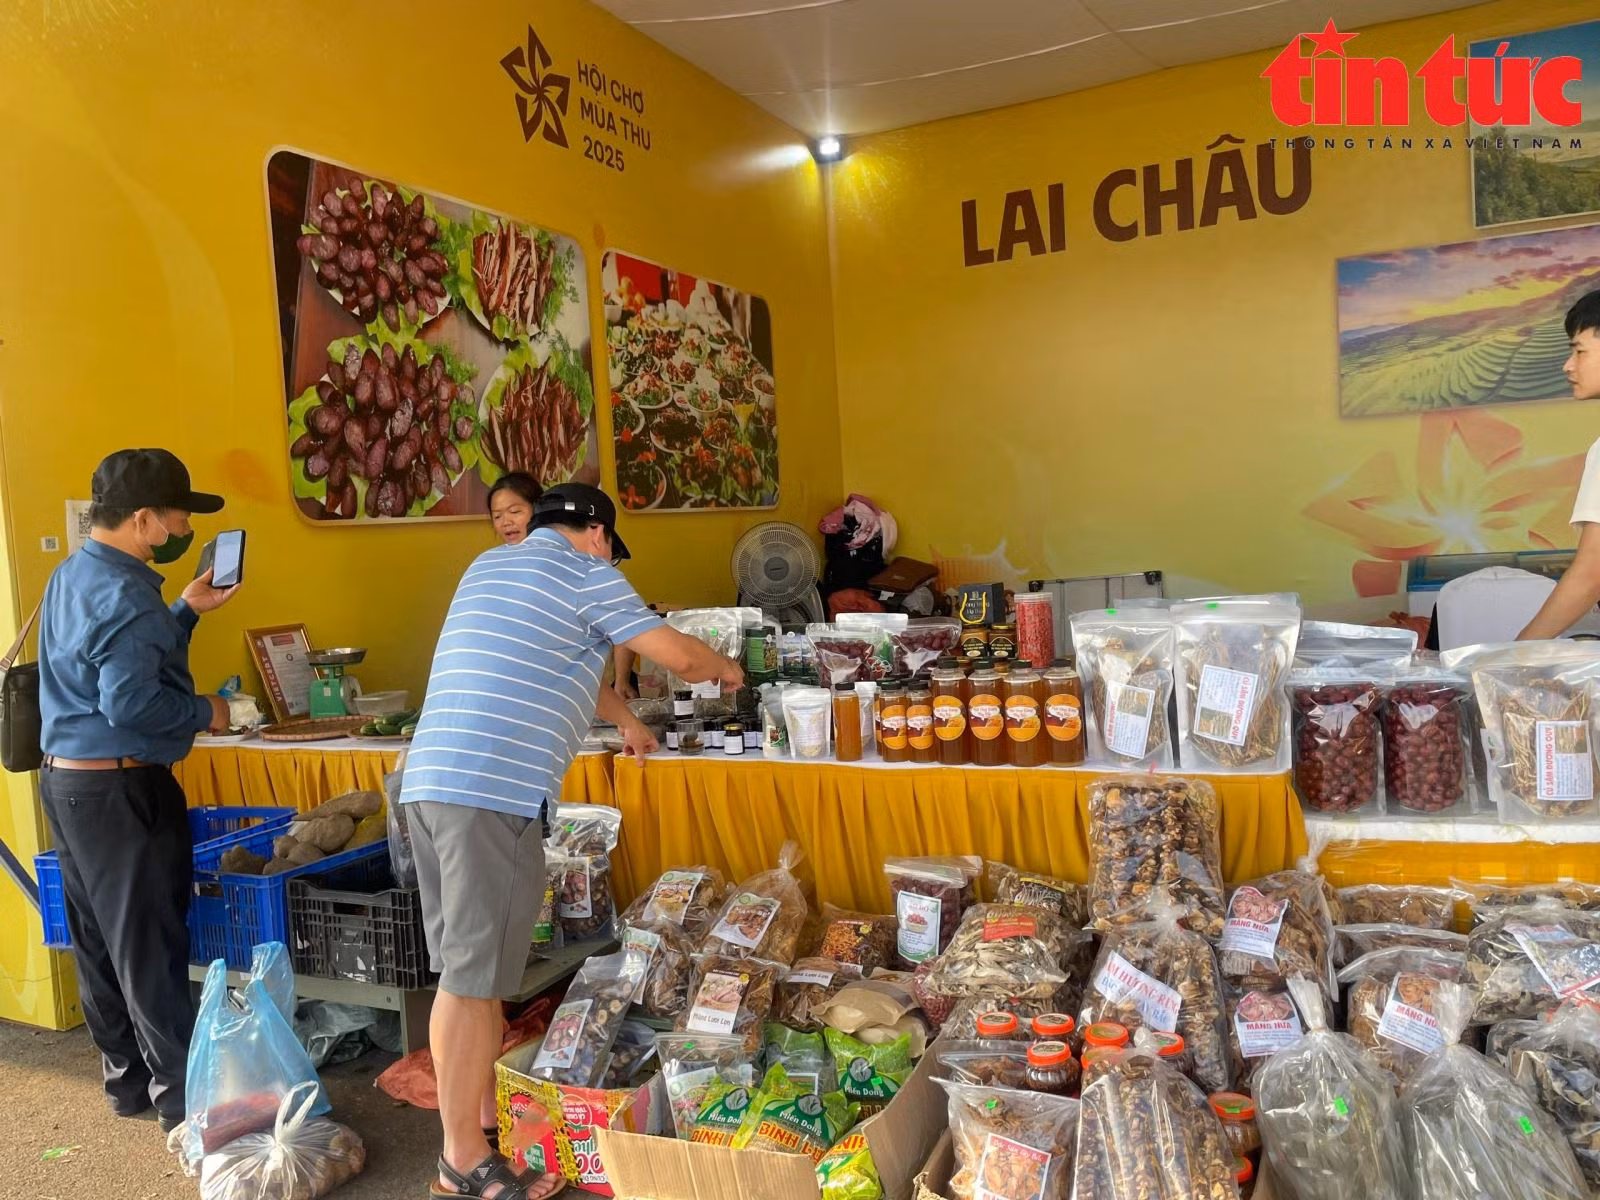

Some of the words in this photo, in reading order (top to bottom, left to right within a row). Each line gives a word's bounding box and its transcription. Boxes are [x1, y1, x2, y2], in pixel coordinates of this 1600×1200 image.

[577, 60, 607, 96] HỘI
[610, 79, 644, 118] CHỢ
[579, 96, 618, 136] MÙA
[620, 116, 651, 151] THU
[582, 134, 625, 172] 2025
[961, 182, 1066, 267] LAI
[1092, 133, 1312, 243] CHÂU
[726, 1114, 744, 1125] Don
[757, 1120, 801, 1150] BÌNH
[800, 1119, 822, 1137] Dong
